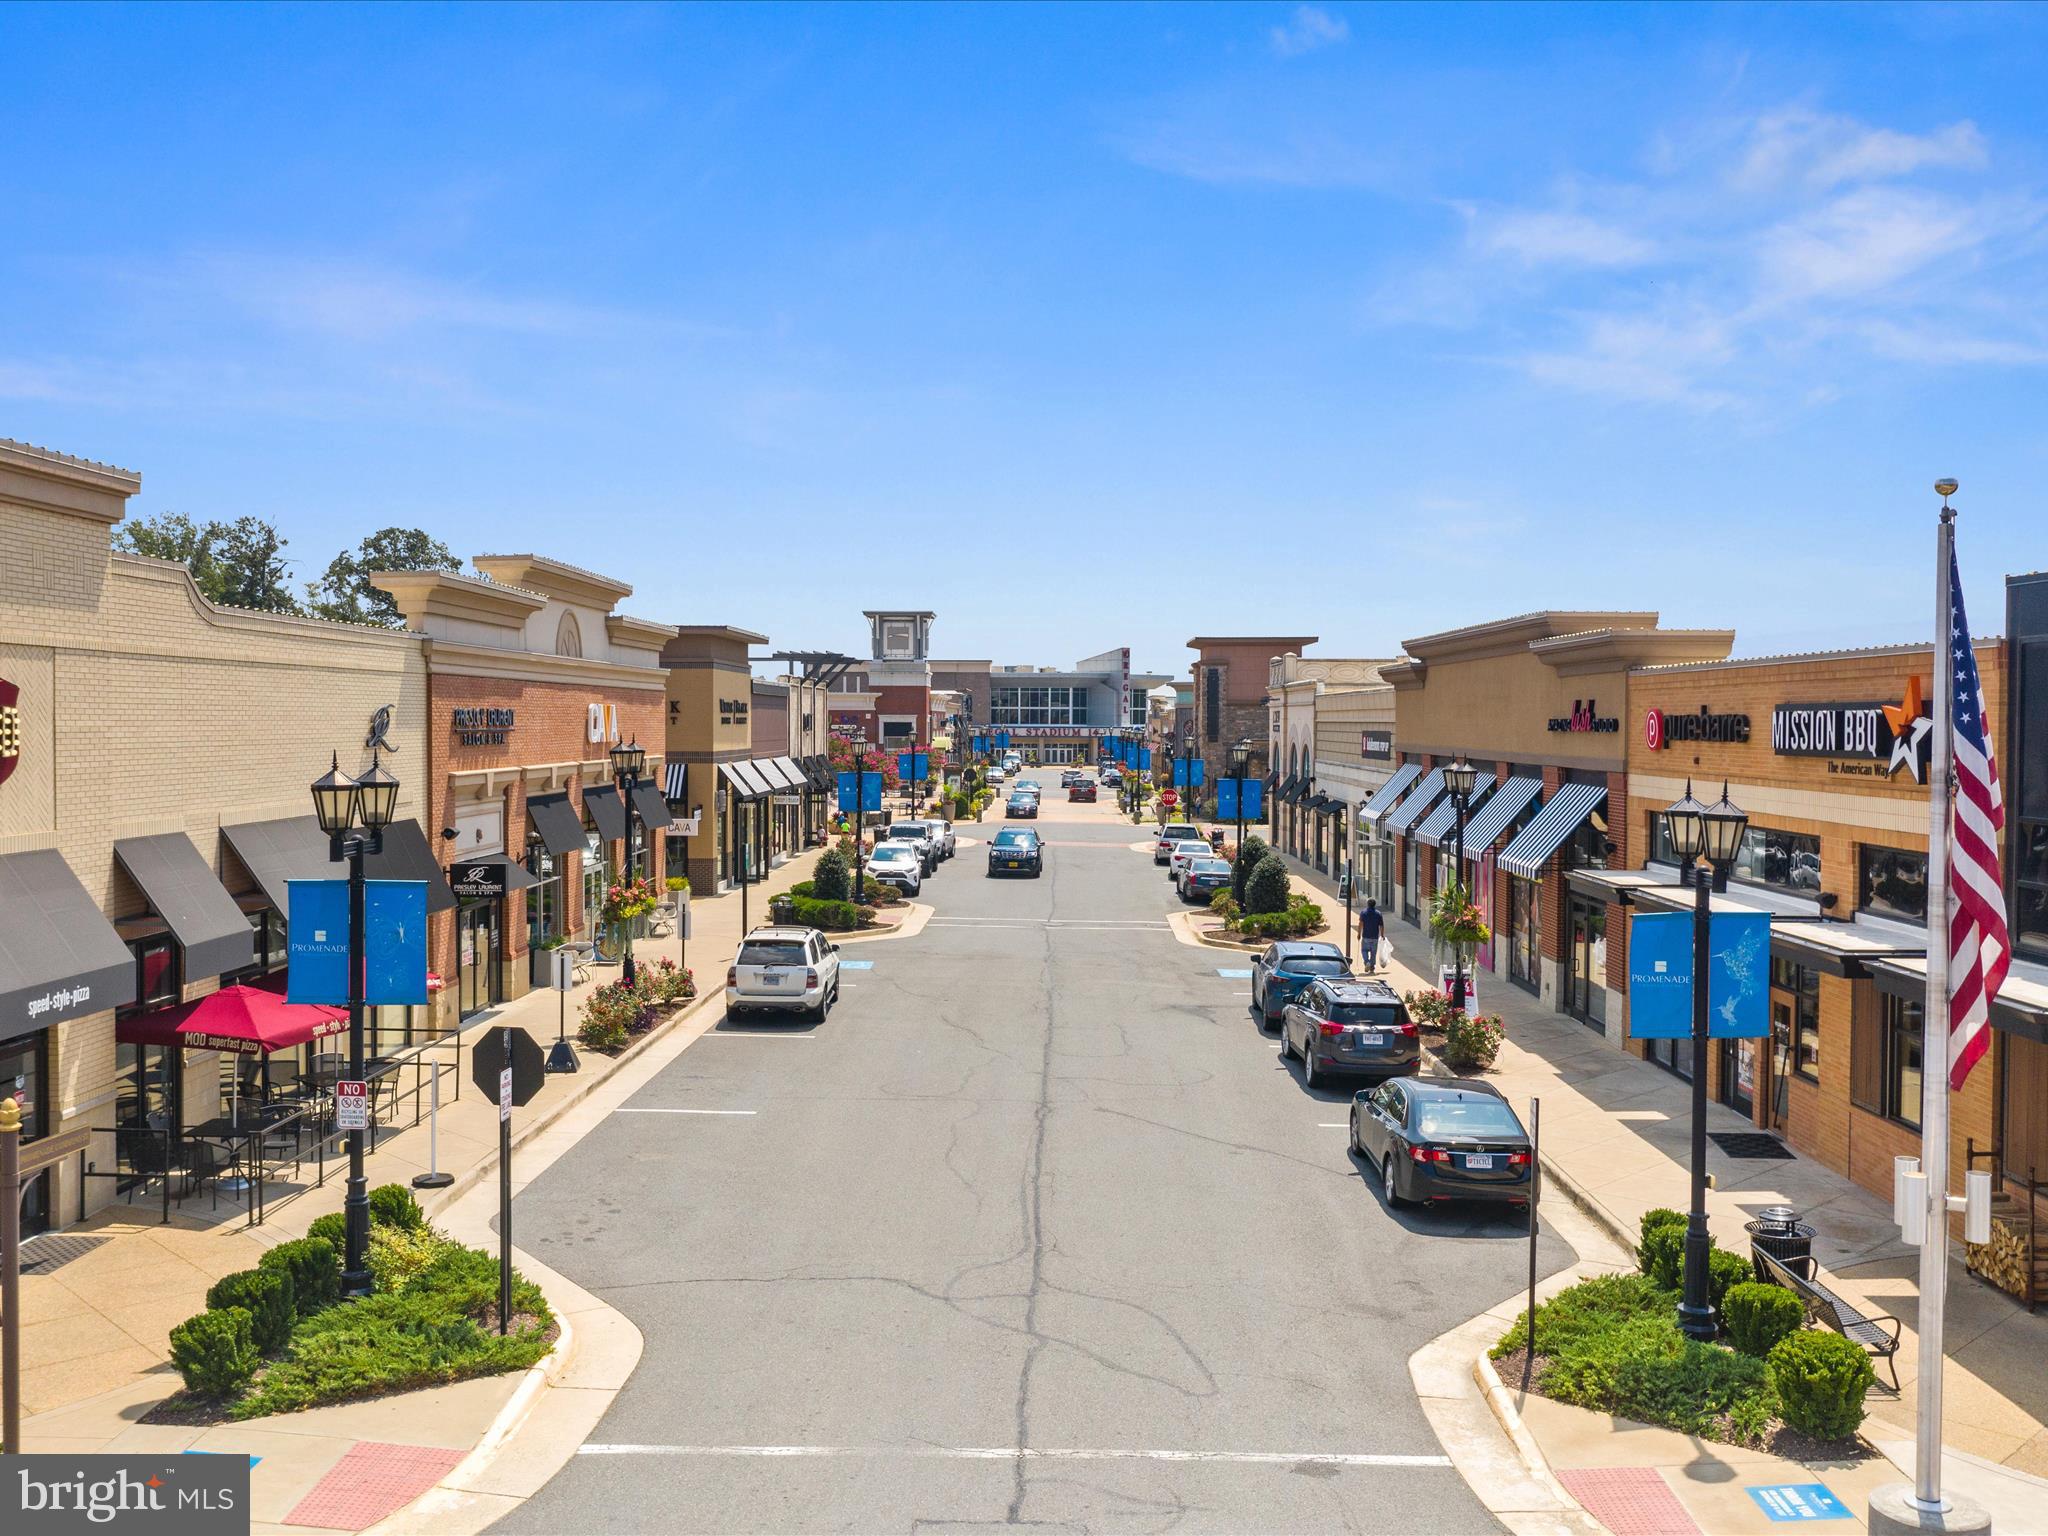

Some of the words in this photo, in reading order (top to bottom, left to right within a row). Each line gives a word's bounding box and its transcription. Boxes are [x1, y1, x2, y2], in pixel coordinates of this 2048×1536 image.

[588, 703, 618, 743] CAVA
[1663, 714, 1698, 749] pure
[1700, 705, 1749, 743] barre
[1026, 728, 1081, 737] STADIUM
[1772, 710, 1836, 750] MISSION
[1844, 709, 1877, 758] BBQ
[1828, 760, 1839, 773] The
[1840, 762, 1873, 776] American
[668, 823, 691, 832] CAVA
[291, 944, 348, 953] PROMENADE
[1631, 974, 1690, 984] PROMENADE
[28, 992, 50, 1019] speed
[52, 988, 70, 1012] style
[73, 984, 90, 1008] pizza
[184, 1032, 206, 1046] MOD
[208, 1037, 240, 1049] superfast
[240, 1039, 258, 1052] pizza
[344, 1084, 360, 1095] NO
